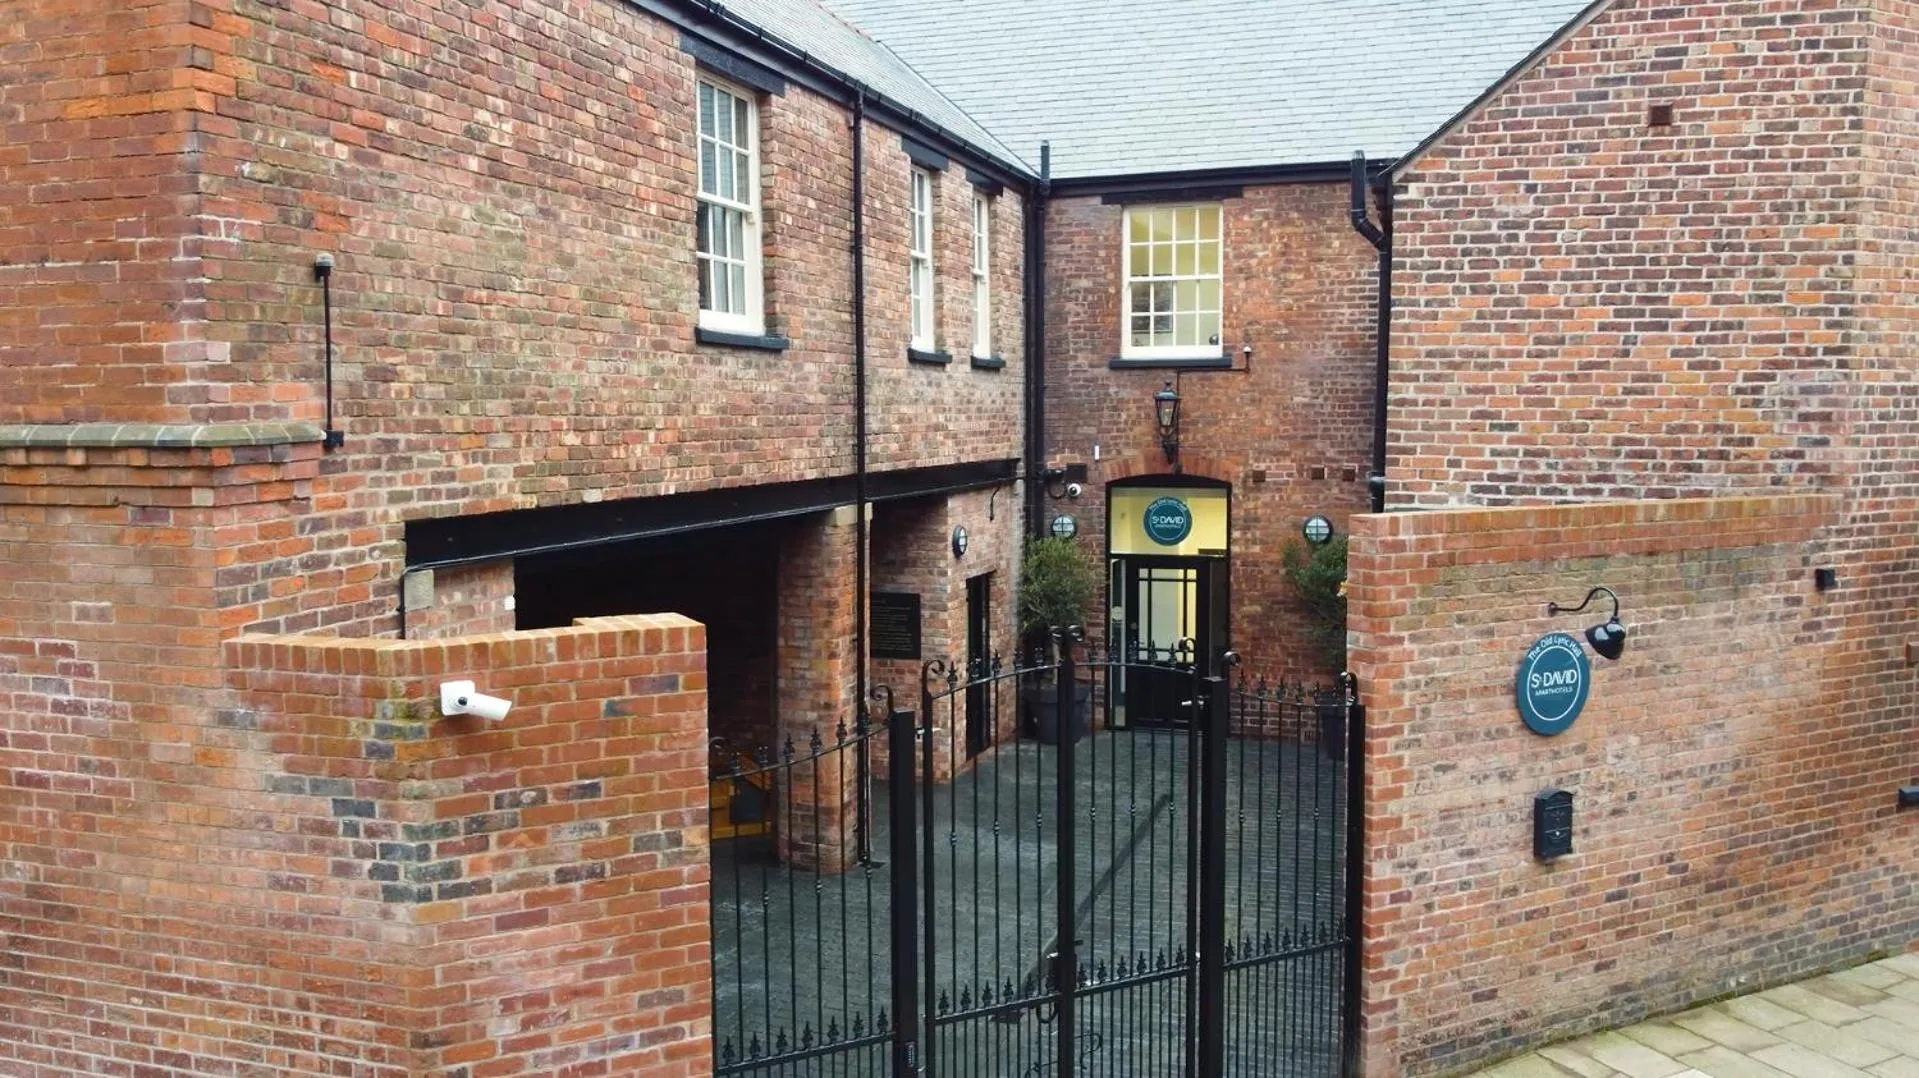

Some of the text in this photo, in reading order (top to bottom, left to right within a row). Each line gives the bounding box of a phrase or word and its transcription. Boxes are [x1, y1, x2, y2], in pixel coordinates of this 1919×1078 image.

[1528, 646, 1541, 660] The
[1540, 635, 1553, 648] Old
[1543, 669, 1577, 687] DAVID
